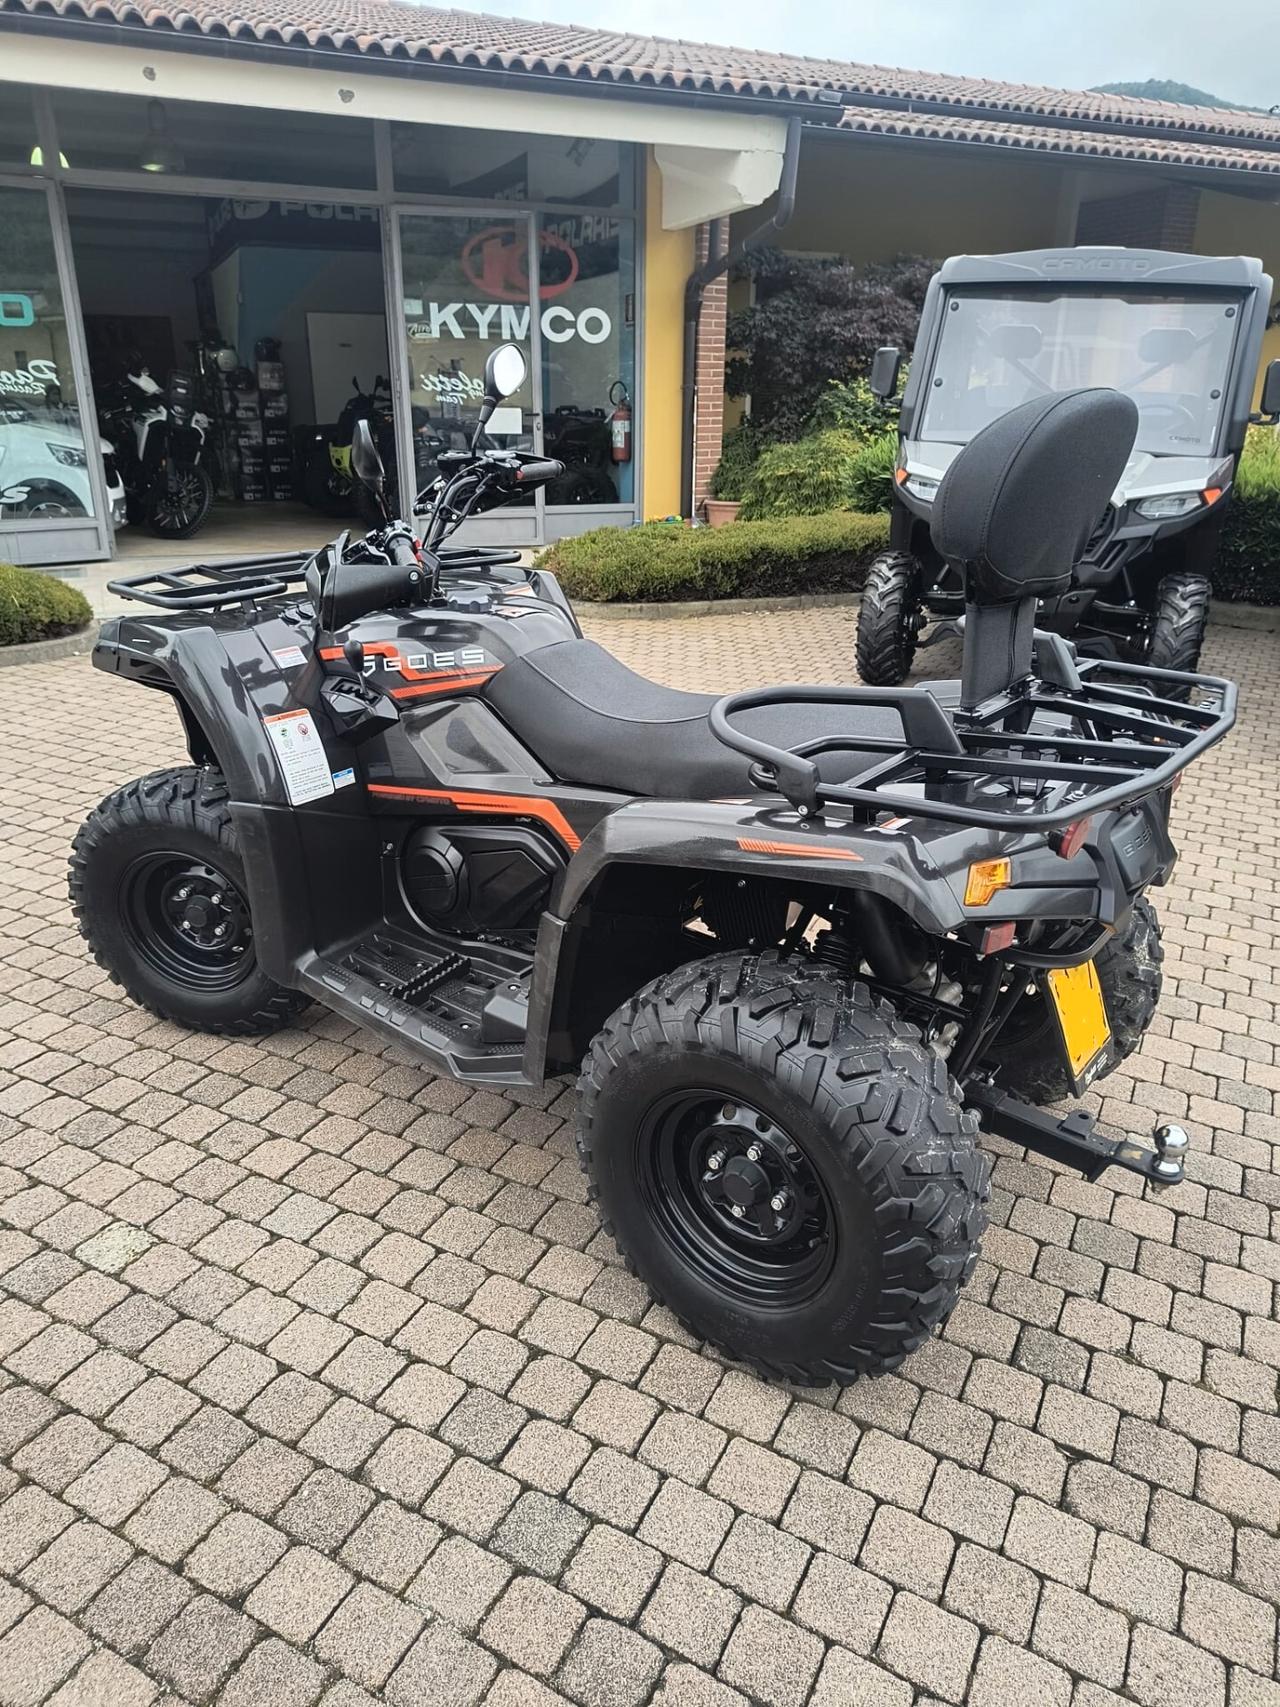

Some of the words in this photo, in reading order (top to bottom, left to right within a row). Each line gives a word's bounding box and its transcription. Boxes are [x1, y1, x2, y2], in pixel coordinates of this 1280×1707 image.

[1041, 256, 1151, 272] CFMOTO
[429, 302, 612, 344] KYMCO
[383, 648, 484, 672] GOES
